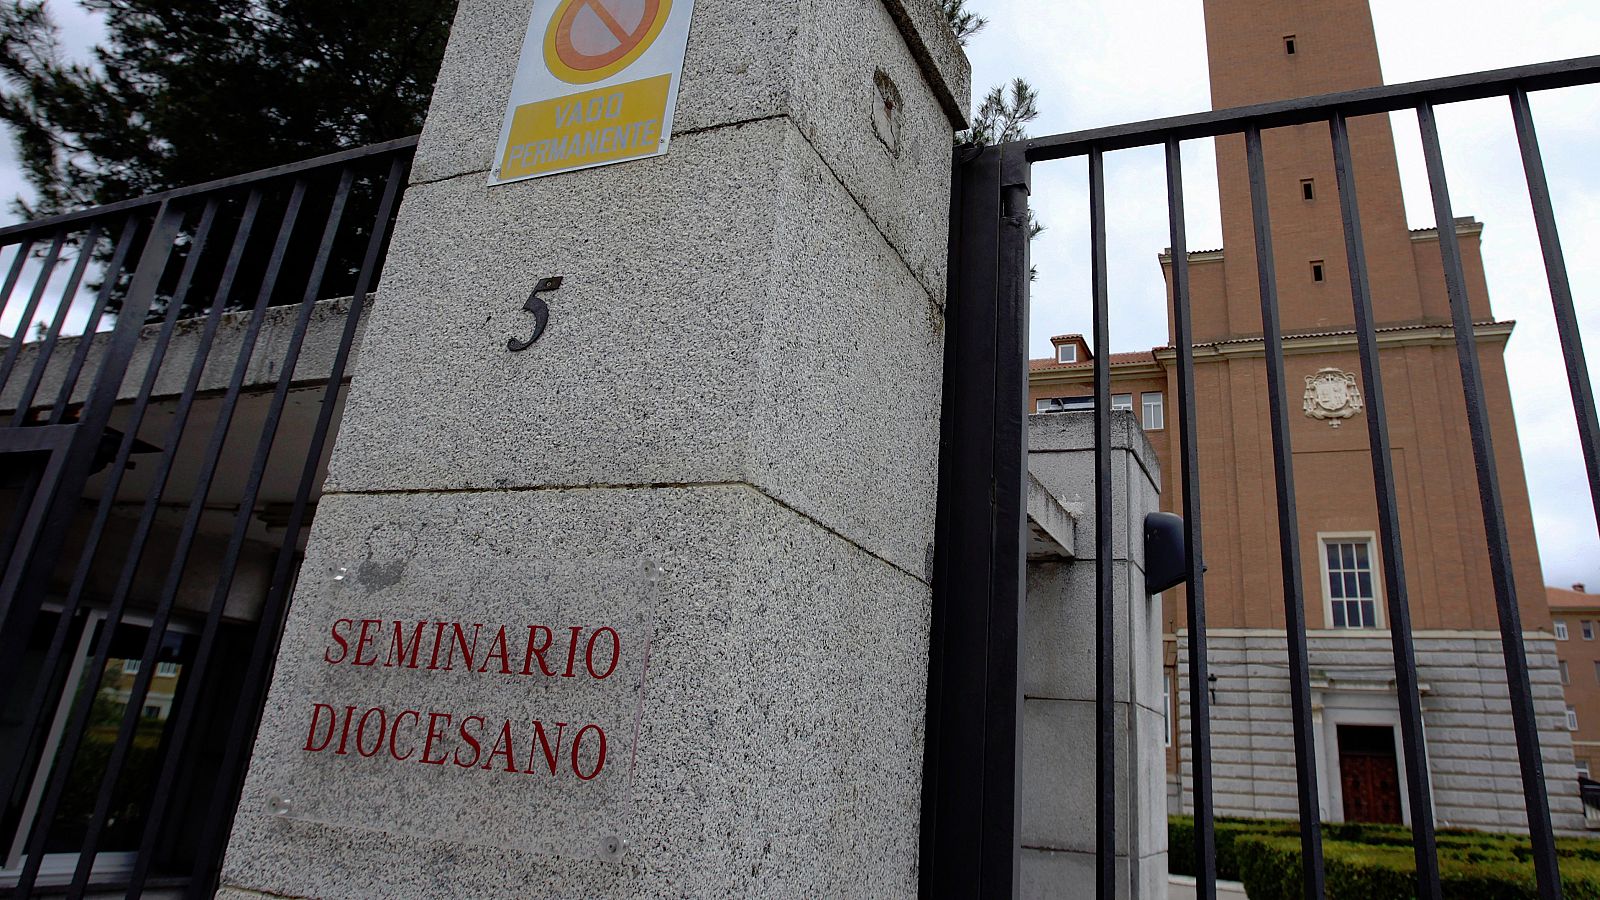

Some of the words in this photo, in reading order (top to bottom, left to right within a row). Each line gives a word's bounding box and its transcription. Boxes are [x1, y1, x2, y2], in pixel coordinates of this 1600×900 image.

[555, 92, 624, 129] VADO
[507, 119, 657, 170] PERMANENTE
[507, 276, 563, 352] 5
[324, 618, 620, 680] SEMINARIO
[303, 703, 607, 781] DIOCESANO
